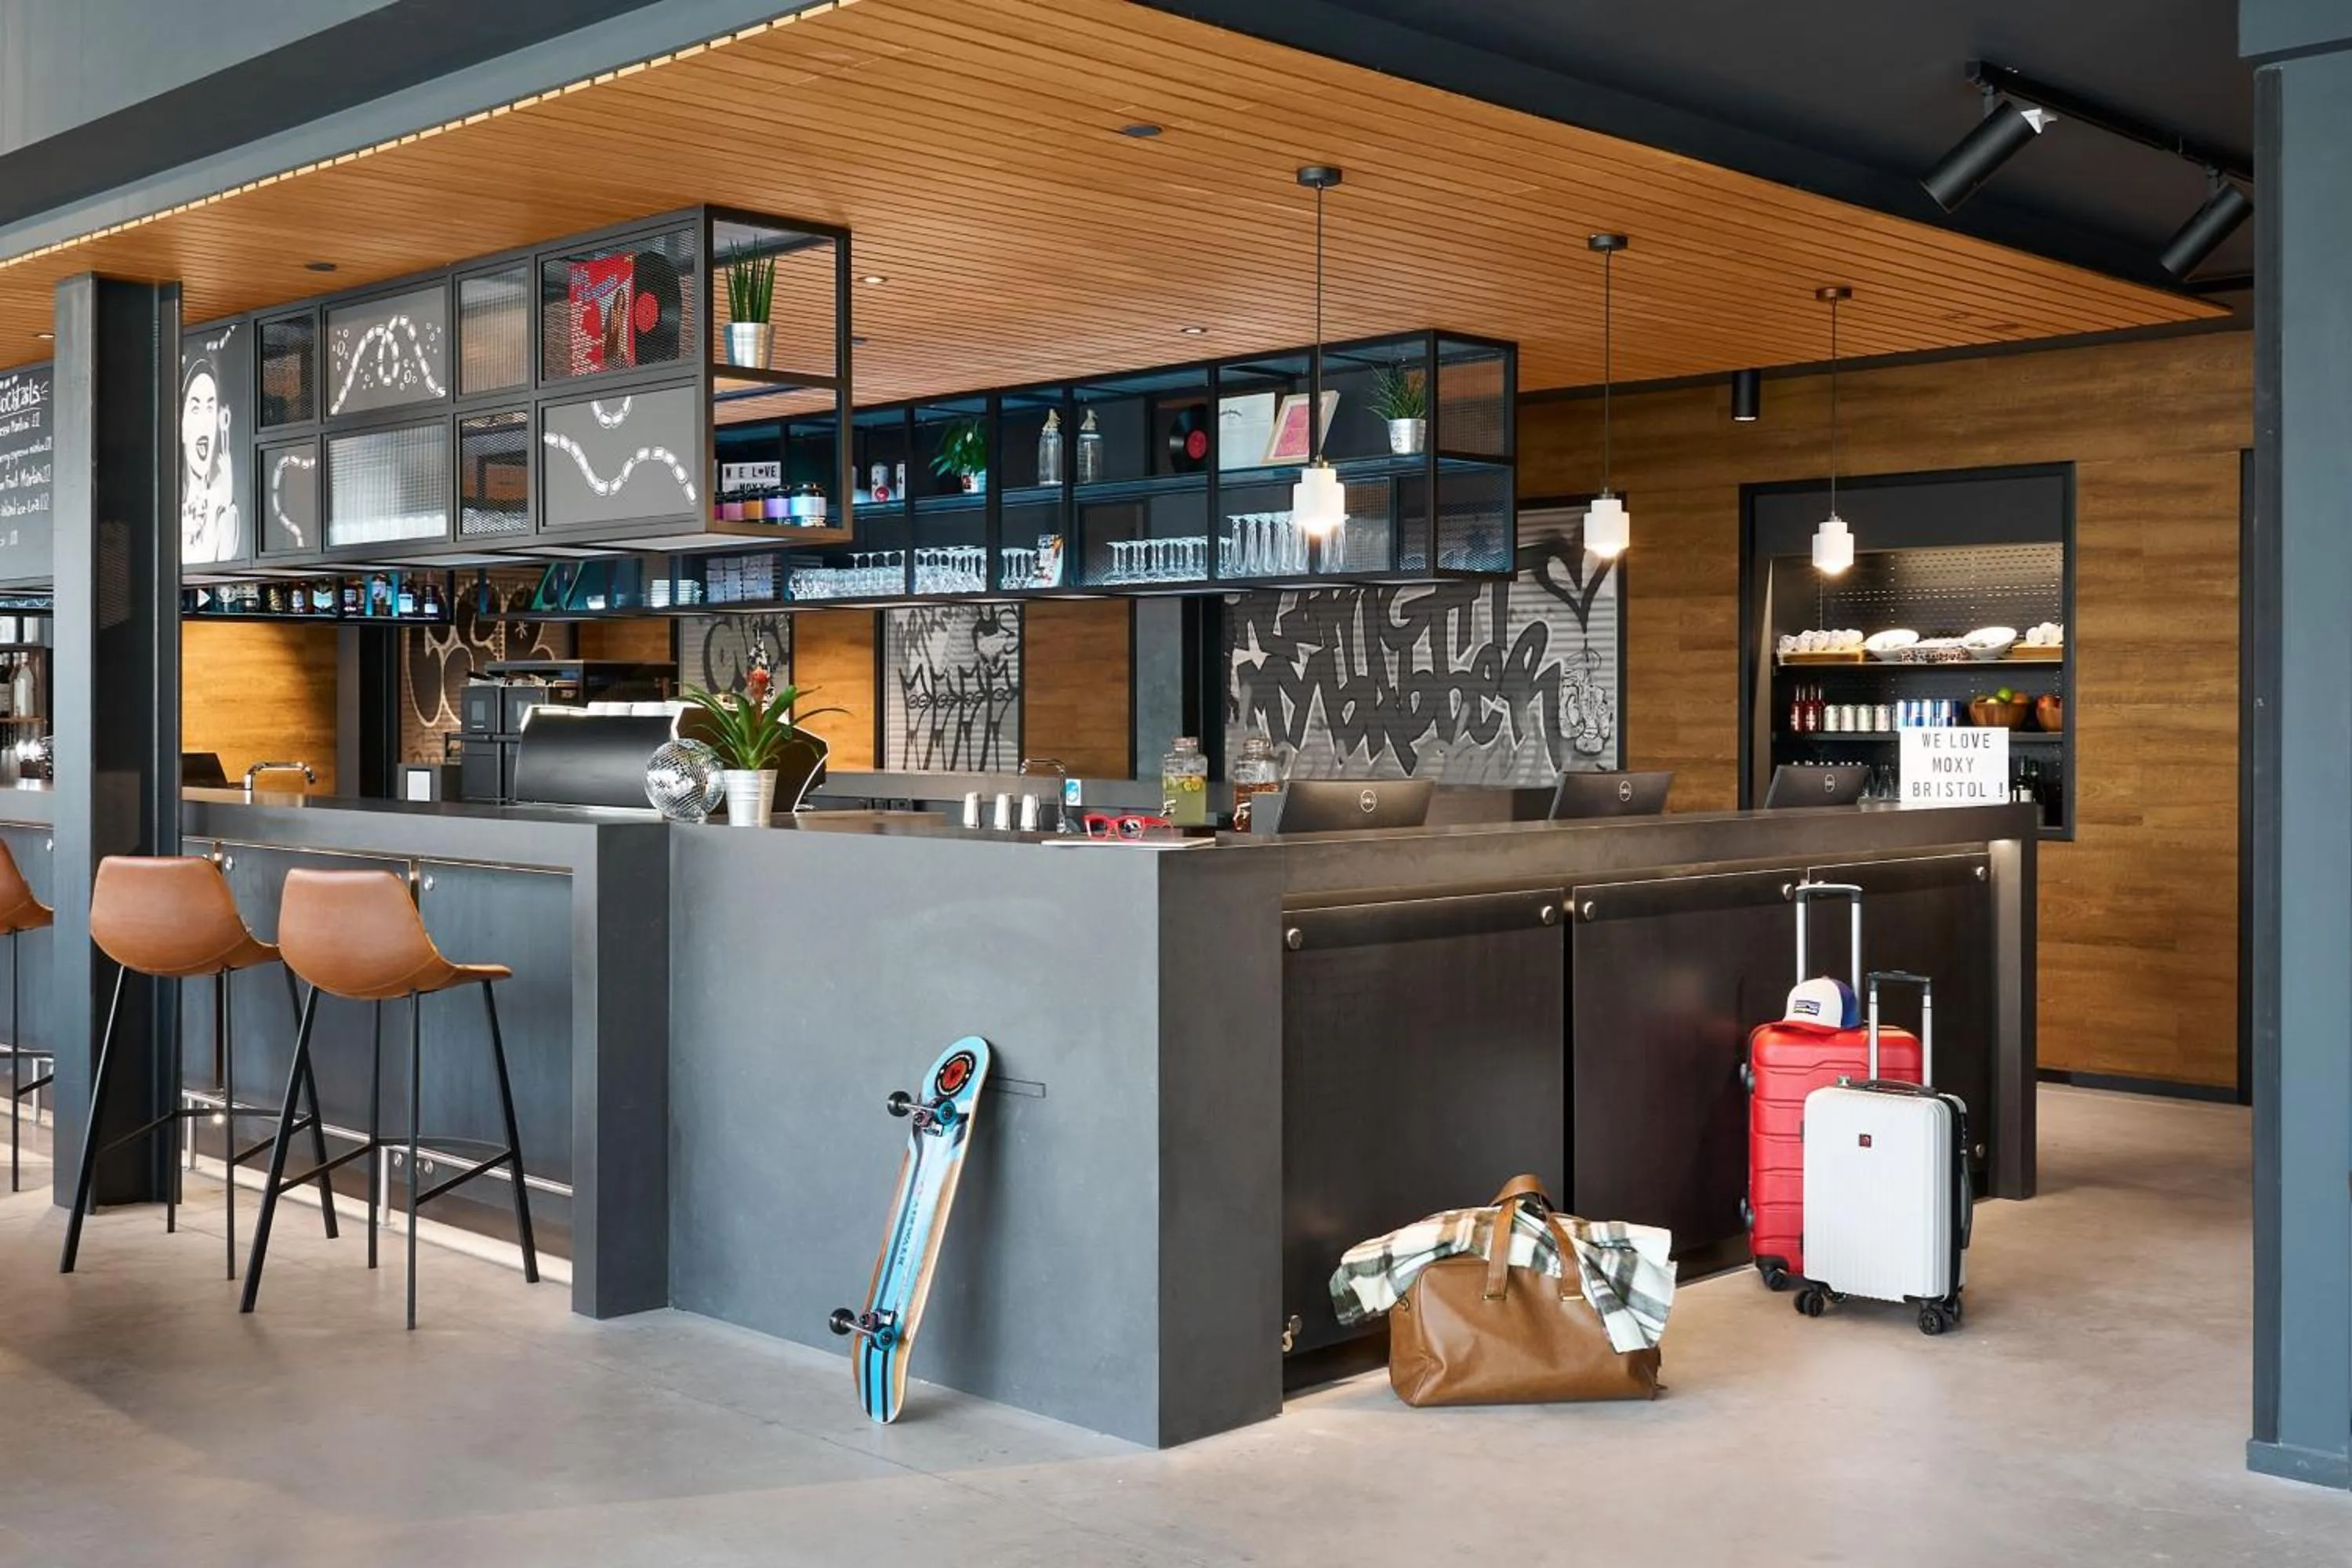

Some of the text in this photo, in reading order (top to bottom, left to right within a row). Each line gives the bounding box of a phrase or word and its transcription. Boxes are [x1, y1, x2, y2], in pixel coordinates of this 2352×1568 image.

[1922, 732, 1991, 749] WE LOVE
[1933, 757, 1973, 773] MOXY
[1912, 782, 1987, 797] BRISTOL
